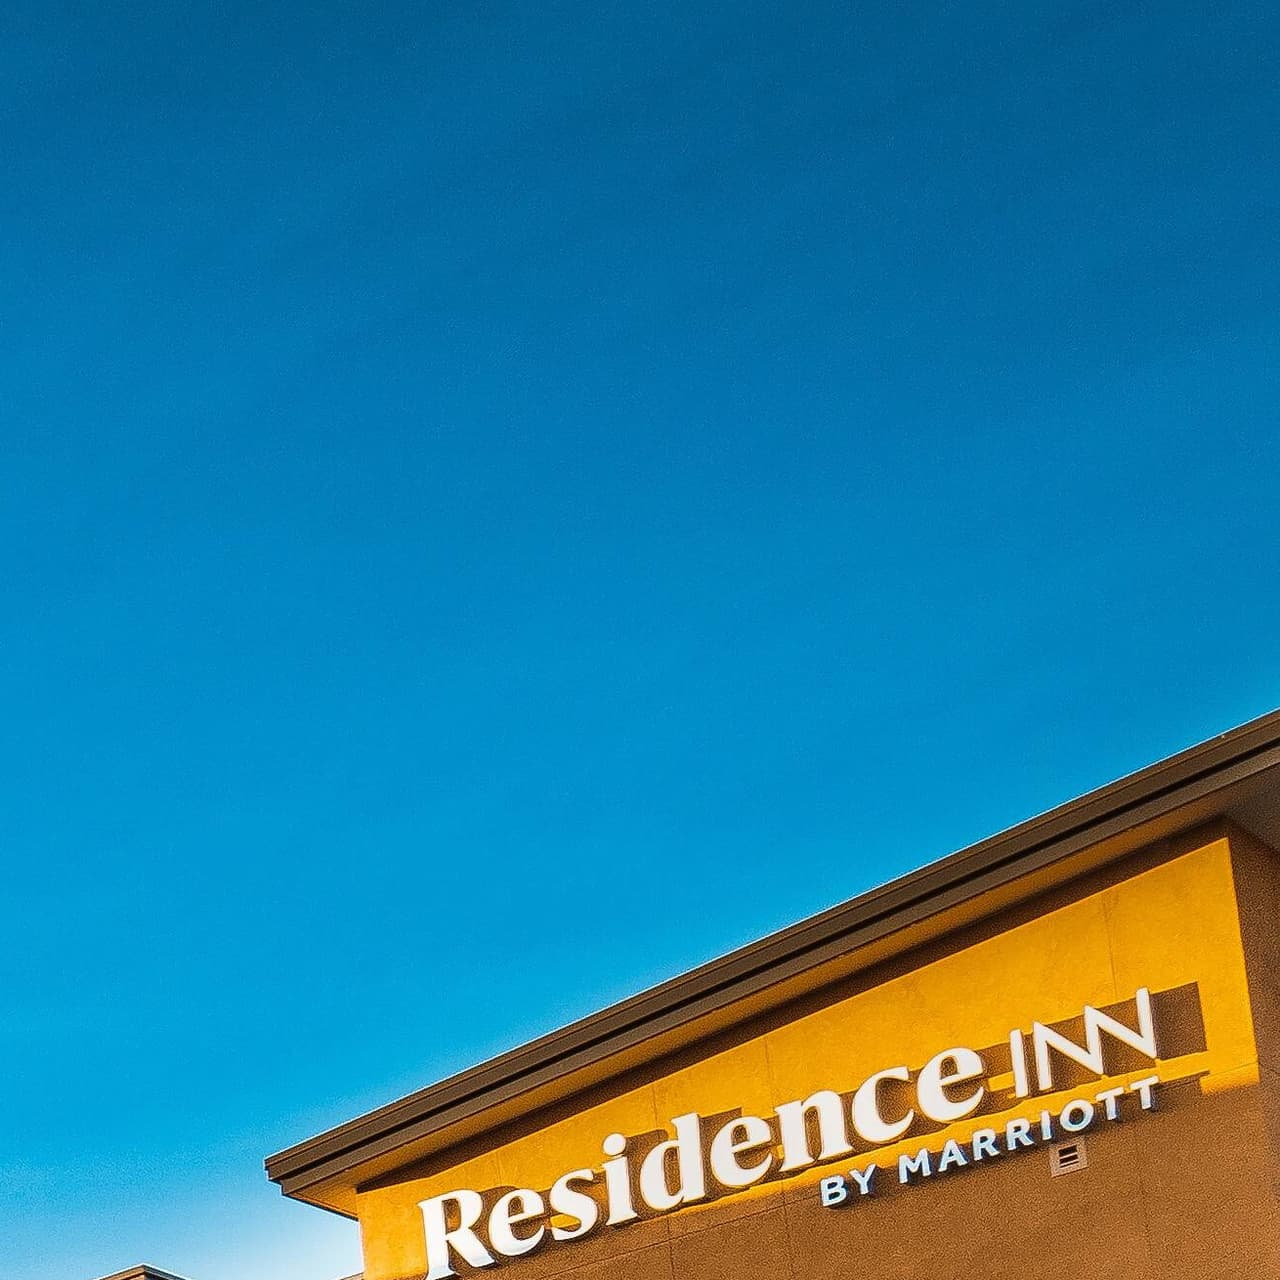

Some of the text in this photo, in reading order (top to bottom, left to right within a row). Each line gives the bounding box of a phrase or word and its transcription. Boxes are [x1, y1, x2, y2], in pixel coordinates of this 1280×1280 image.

[1008, 986, 1158, 1099] INN
[819, 1075, 1160, 1207] BY MARRIOTT
